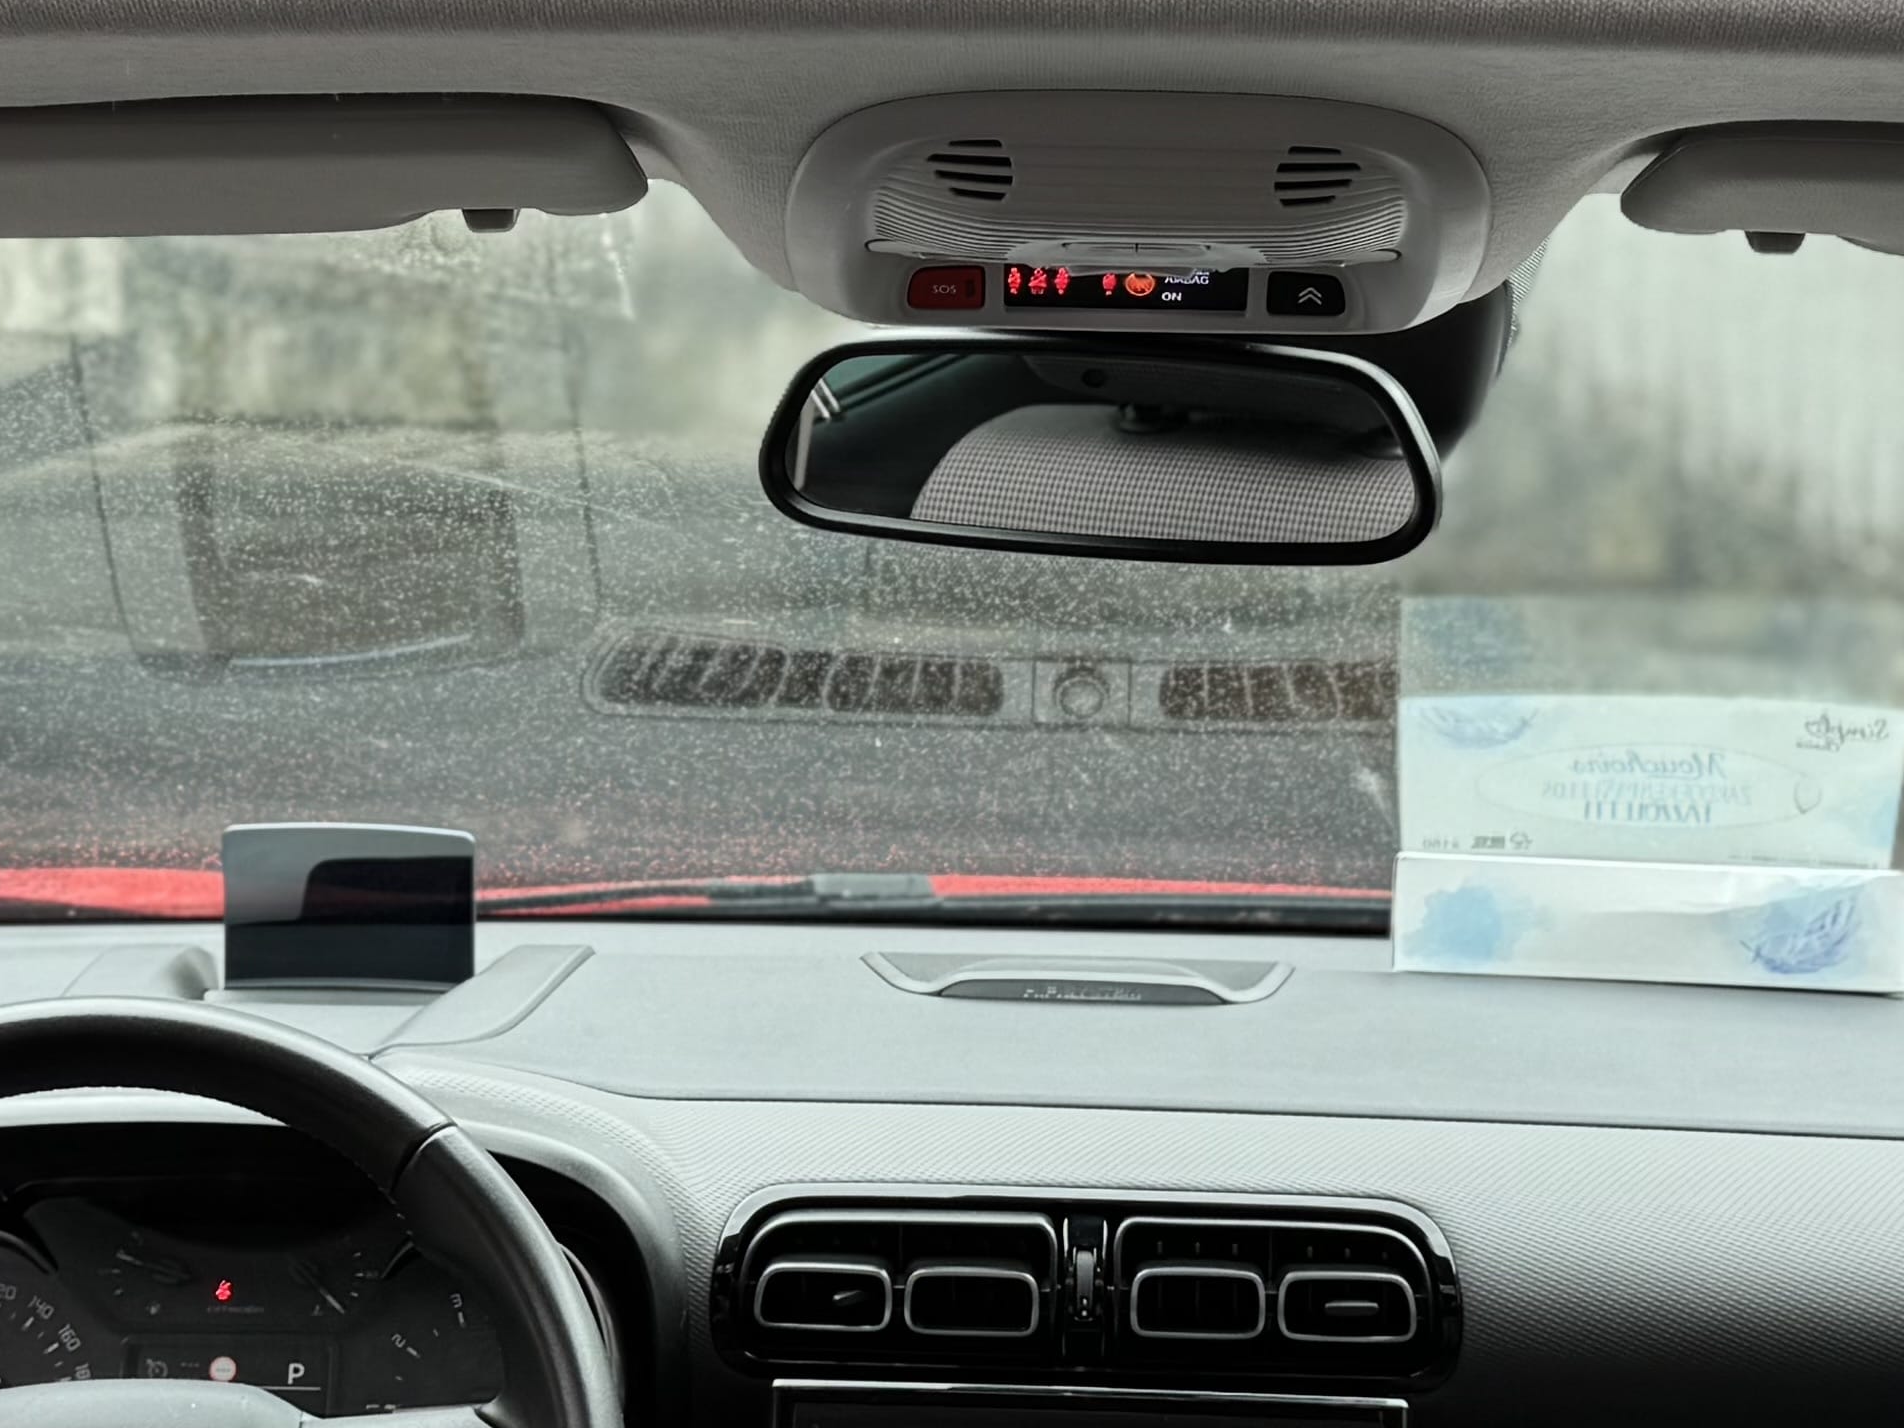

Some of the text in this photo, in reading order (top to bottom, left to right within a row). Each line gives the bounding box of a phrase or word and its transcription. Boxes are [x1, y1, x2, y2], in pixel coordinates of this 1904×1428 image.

[932, 285, 957, 294] SOS
[1161, 291, 1182, 301] ON
[27, 1295, 55, 1320] 140
[449, 1292, 463, 1309] 3
[57, 1323, 81, 1352] 160
[287, 1362, 306, 1385] P
